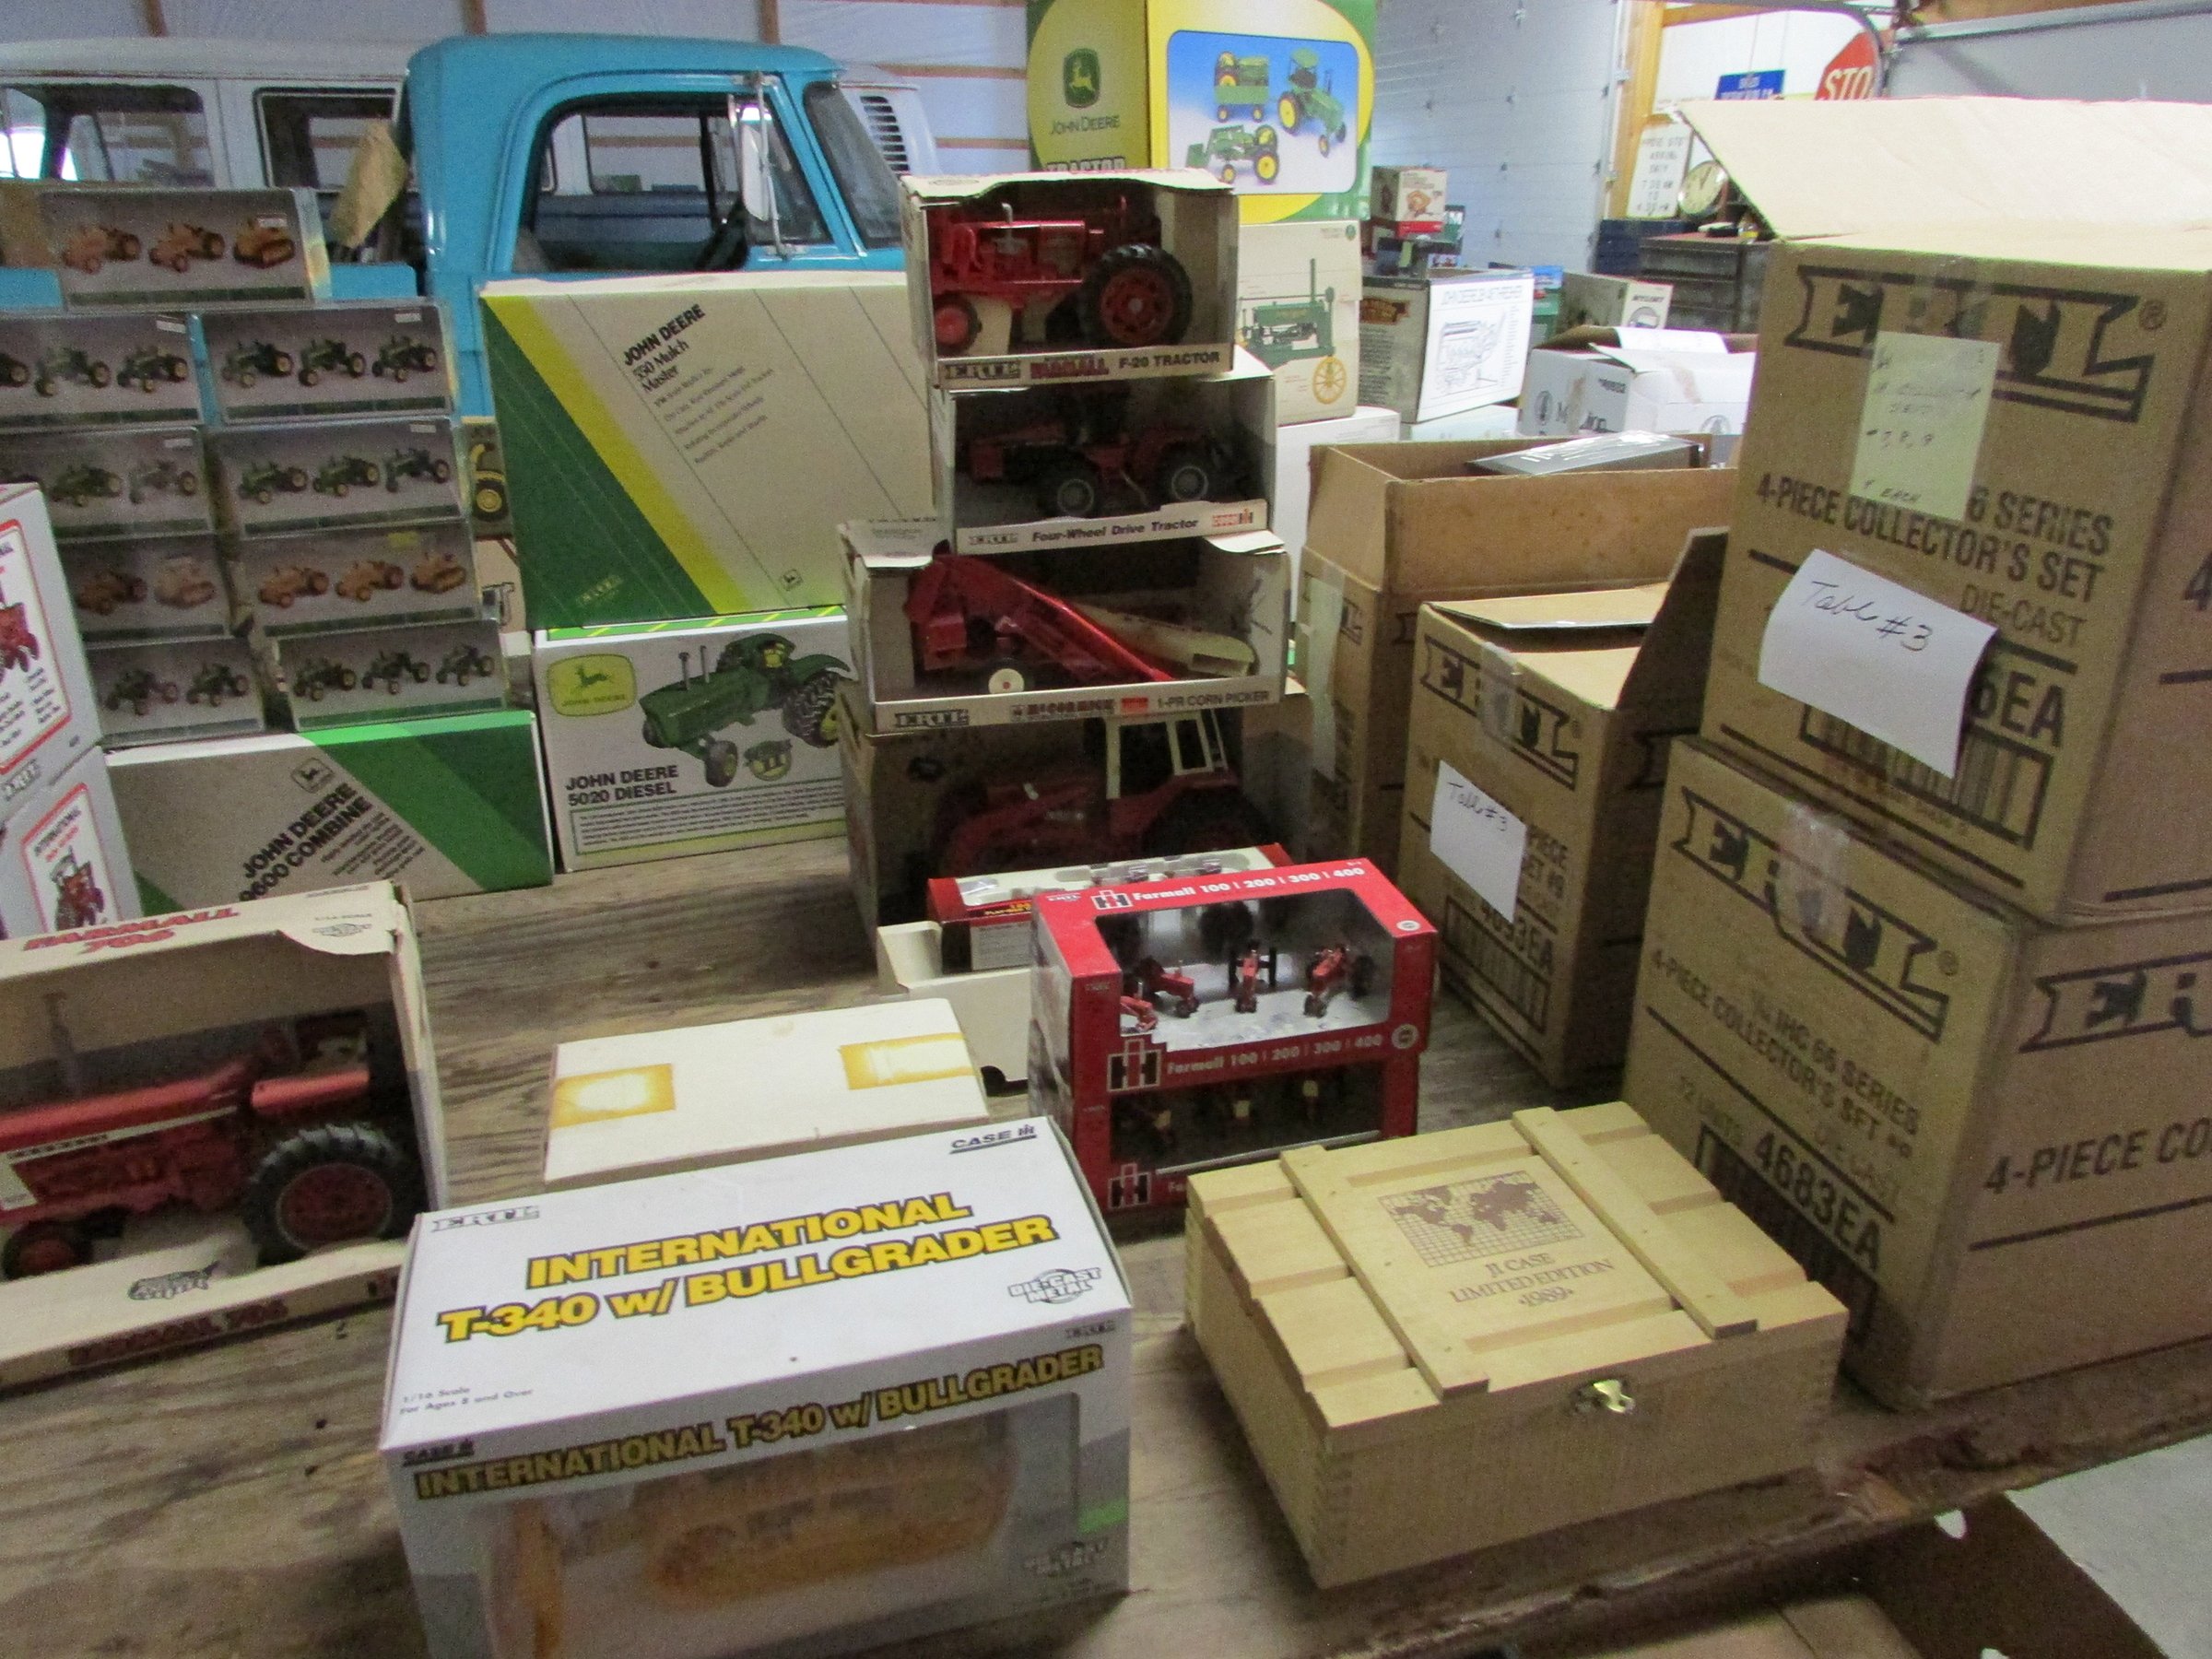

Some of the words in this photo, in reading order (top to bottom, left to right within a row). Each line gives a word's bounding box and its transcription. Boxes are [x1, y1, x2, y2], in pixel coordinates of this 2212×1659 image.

[1825, 65, 1875, 100] STO
[1081, 114, 1121, 132] DEERE
[623, 333, 662, 367] JOHN
[658, 302, 706, 341] DEERE
[653, 338, 690, 367] Mulch
[641, 365, 680, 393] Master
[1118, 356, 1150, 369] F-20
[1153, 350, 1220, 367] TRACTOR
[1031, 525, 1107, 543] Four-Wheel
[1111, 521, 1146, 535] Drive
[1151, 518, 1198, 532] Tractor
[1755, 472, 1841, 525] 4-PIECE
[1844, 494, 2031, 583] COLLECTOR'S
[2036, 550, 2105, 604] SET
[1993, 488, 2114, 555] SERIES
[1798, 580, 1879, 625] Table
[1876, 616, 1934, 653] #3
[1959, 582, 2088, 648] DIE-CAST
[1186, 694, 1224, 708] CORN
[1225, 690, 1270, 704] PICKER
[565, 774, 617, 792] JOHN
[619, 764, 679, 784] DEERE
[568, 790, 611, 807] 5020
[615, 782, 677, 802] DIESEL
[242, 833, 294, 878] JOHN
[288, 782, 357, 840] DEERE
[284, 795, 373, 867] COMBINE
[1132, 886, 1196, 902] Farmall
[1199, 882, 1231, 894] 100
[1242, 877, 1277, 889] 200
[1288, 872, 1321, 884] 300
[1332, 866, 1366, 878] 400
[1167, 1055, 1224, 1075] Farmall
[1230, 1053, 1259, 1066] 100
[1270, 1046, 1301, 1062] 200
[1313, 1040, 1342, 1055] 300
[1354, 1033, 1382, 1048] 400
[1651, 947, 1712, 1009] 4-PIECE
[1712, 995, 1839, 1108] COLLECTOR'S
[1841, 1097, 1880, 1141] SET
[1841, 1059, 1922, 1136] SERIES
[951, 1129, 1013, 1150] CASE
[1983, 1127, 2149, 1196] 4-PIECE
[1753, 1130, 1882, 1271] 4683EA
[525, 1192, 974, 1289] INTERNATIONAL
[1504, 1252, 1556, 1272] CASE
[436, 1291, 601, 1345] T-340
[604, 1276, 682, 1320] w/
[684, 1213, 1060, 1308] BULLGRADER
[1448, 1274, 1536, 1303] LIMITED
[1535, 1258, 1616, 1287] EDITION
[425, 1400, 456, 1411] Ages
[475, 1393, 499, 1403] and
[503, 1389, 533, 1399] Over
[439, 1386, 471, 1396] Scale
[414, 1420, 727, 1501] INTERNATIONAL
[726, 1402, 827, 1449] T-340
[830, 1391, 873, 1430] w/
[876, 1342, 1105, 1421] BULLGRADER
